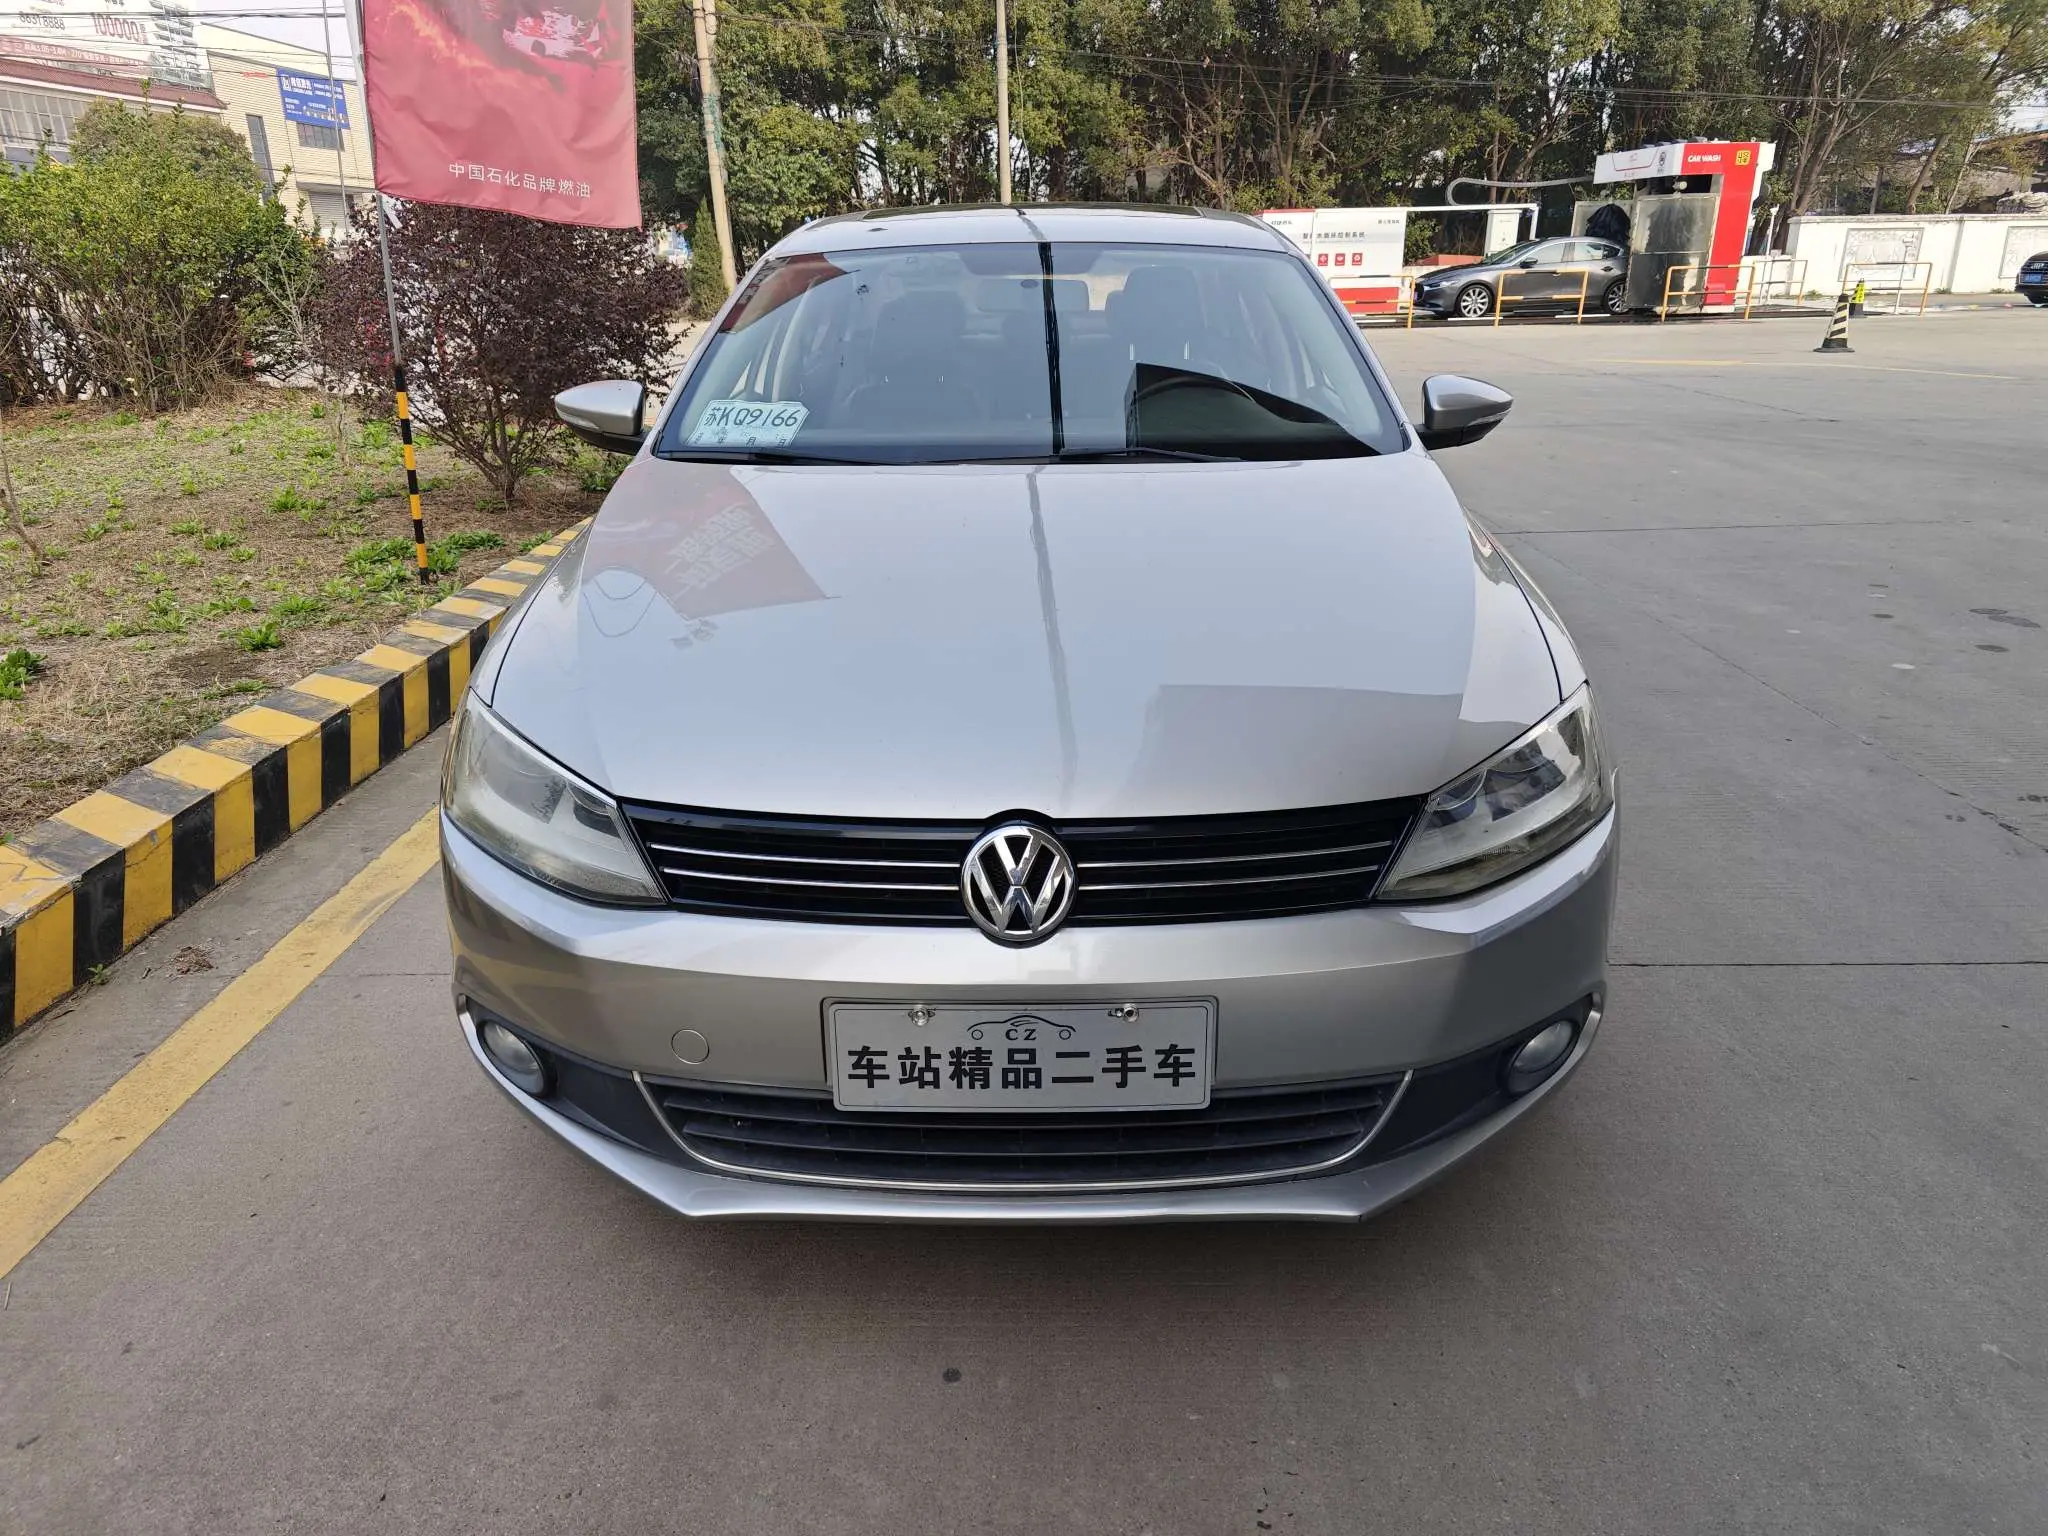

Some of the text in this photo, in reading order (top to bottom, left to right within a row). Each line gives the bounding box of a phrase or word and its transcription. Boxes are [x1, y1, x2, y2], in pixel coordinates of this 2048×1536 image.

[1687, 154, 1721, 163] CAR WASH
[448, 162, 592, 199] 中国石化品牌燃油
[961, 825, 1075, 941] VW
[847, 1043, 1196, 1090] 车站精品二手车
